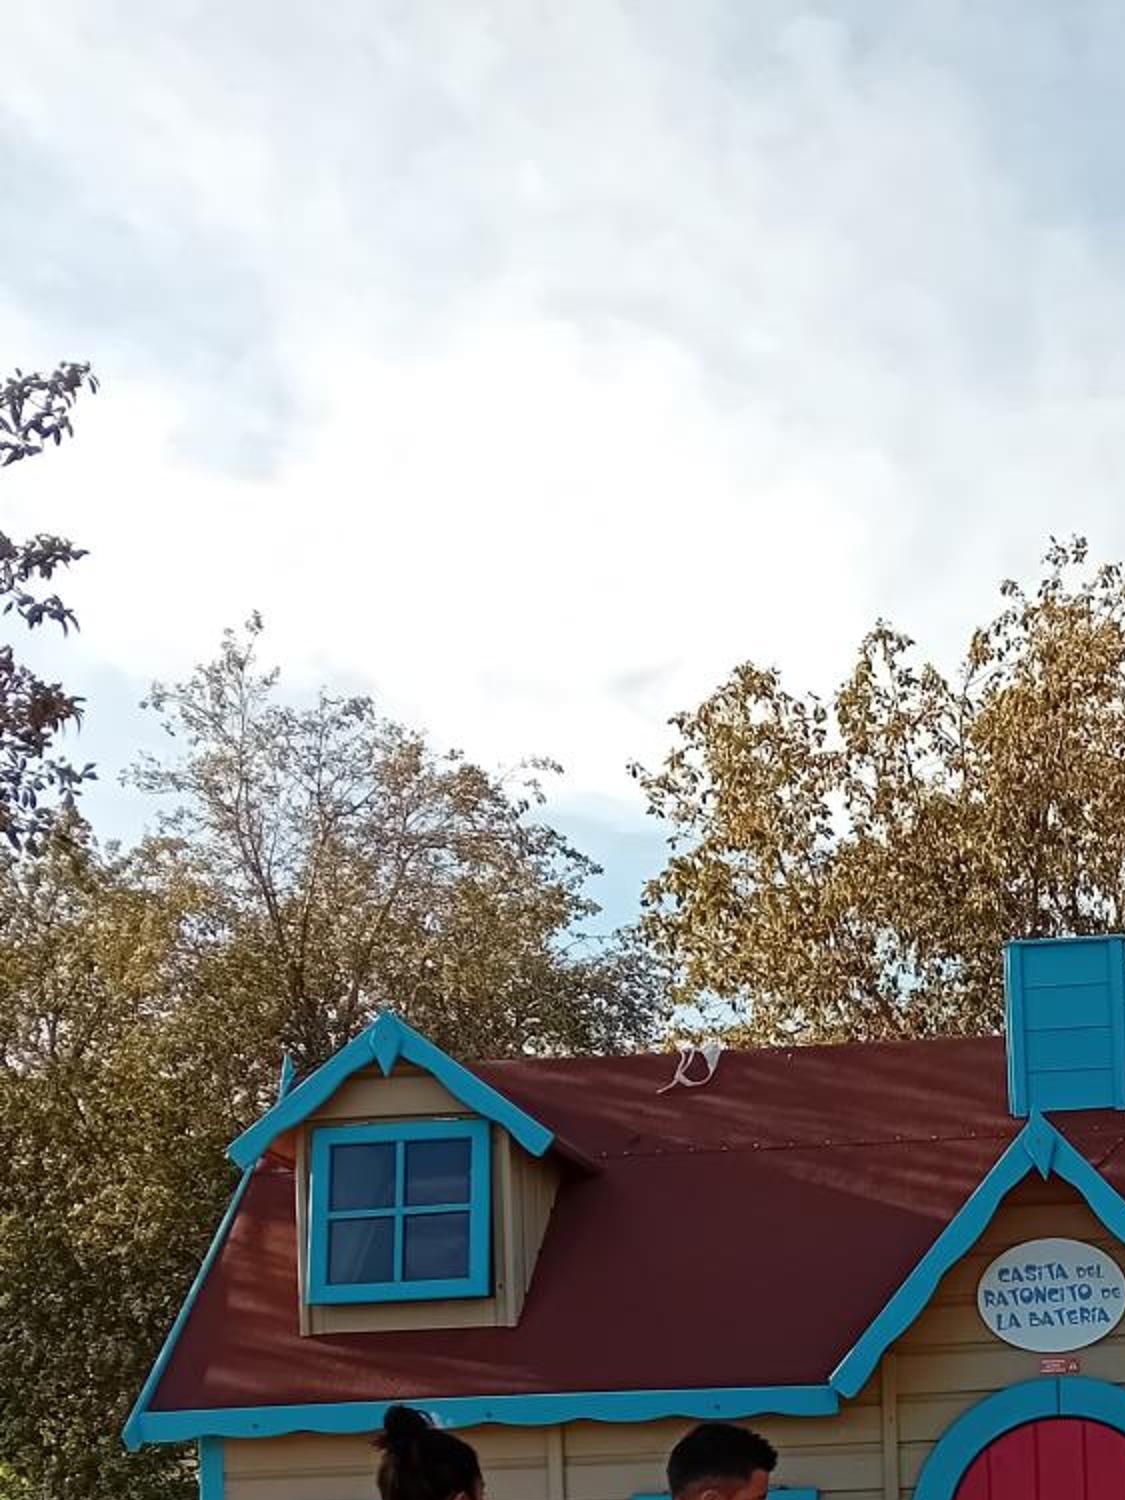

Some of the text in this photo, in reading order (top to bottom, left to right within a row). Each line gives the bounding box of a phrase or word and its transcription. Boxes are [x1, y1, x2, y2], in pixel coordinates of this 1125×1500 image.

[1076, 1264, 1104, 1279] DEL
[983, 1284, 1121, 1308] RATONCITO DE
[996, 1312, 1022, 1331] LA
